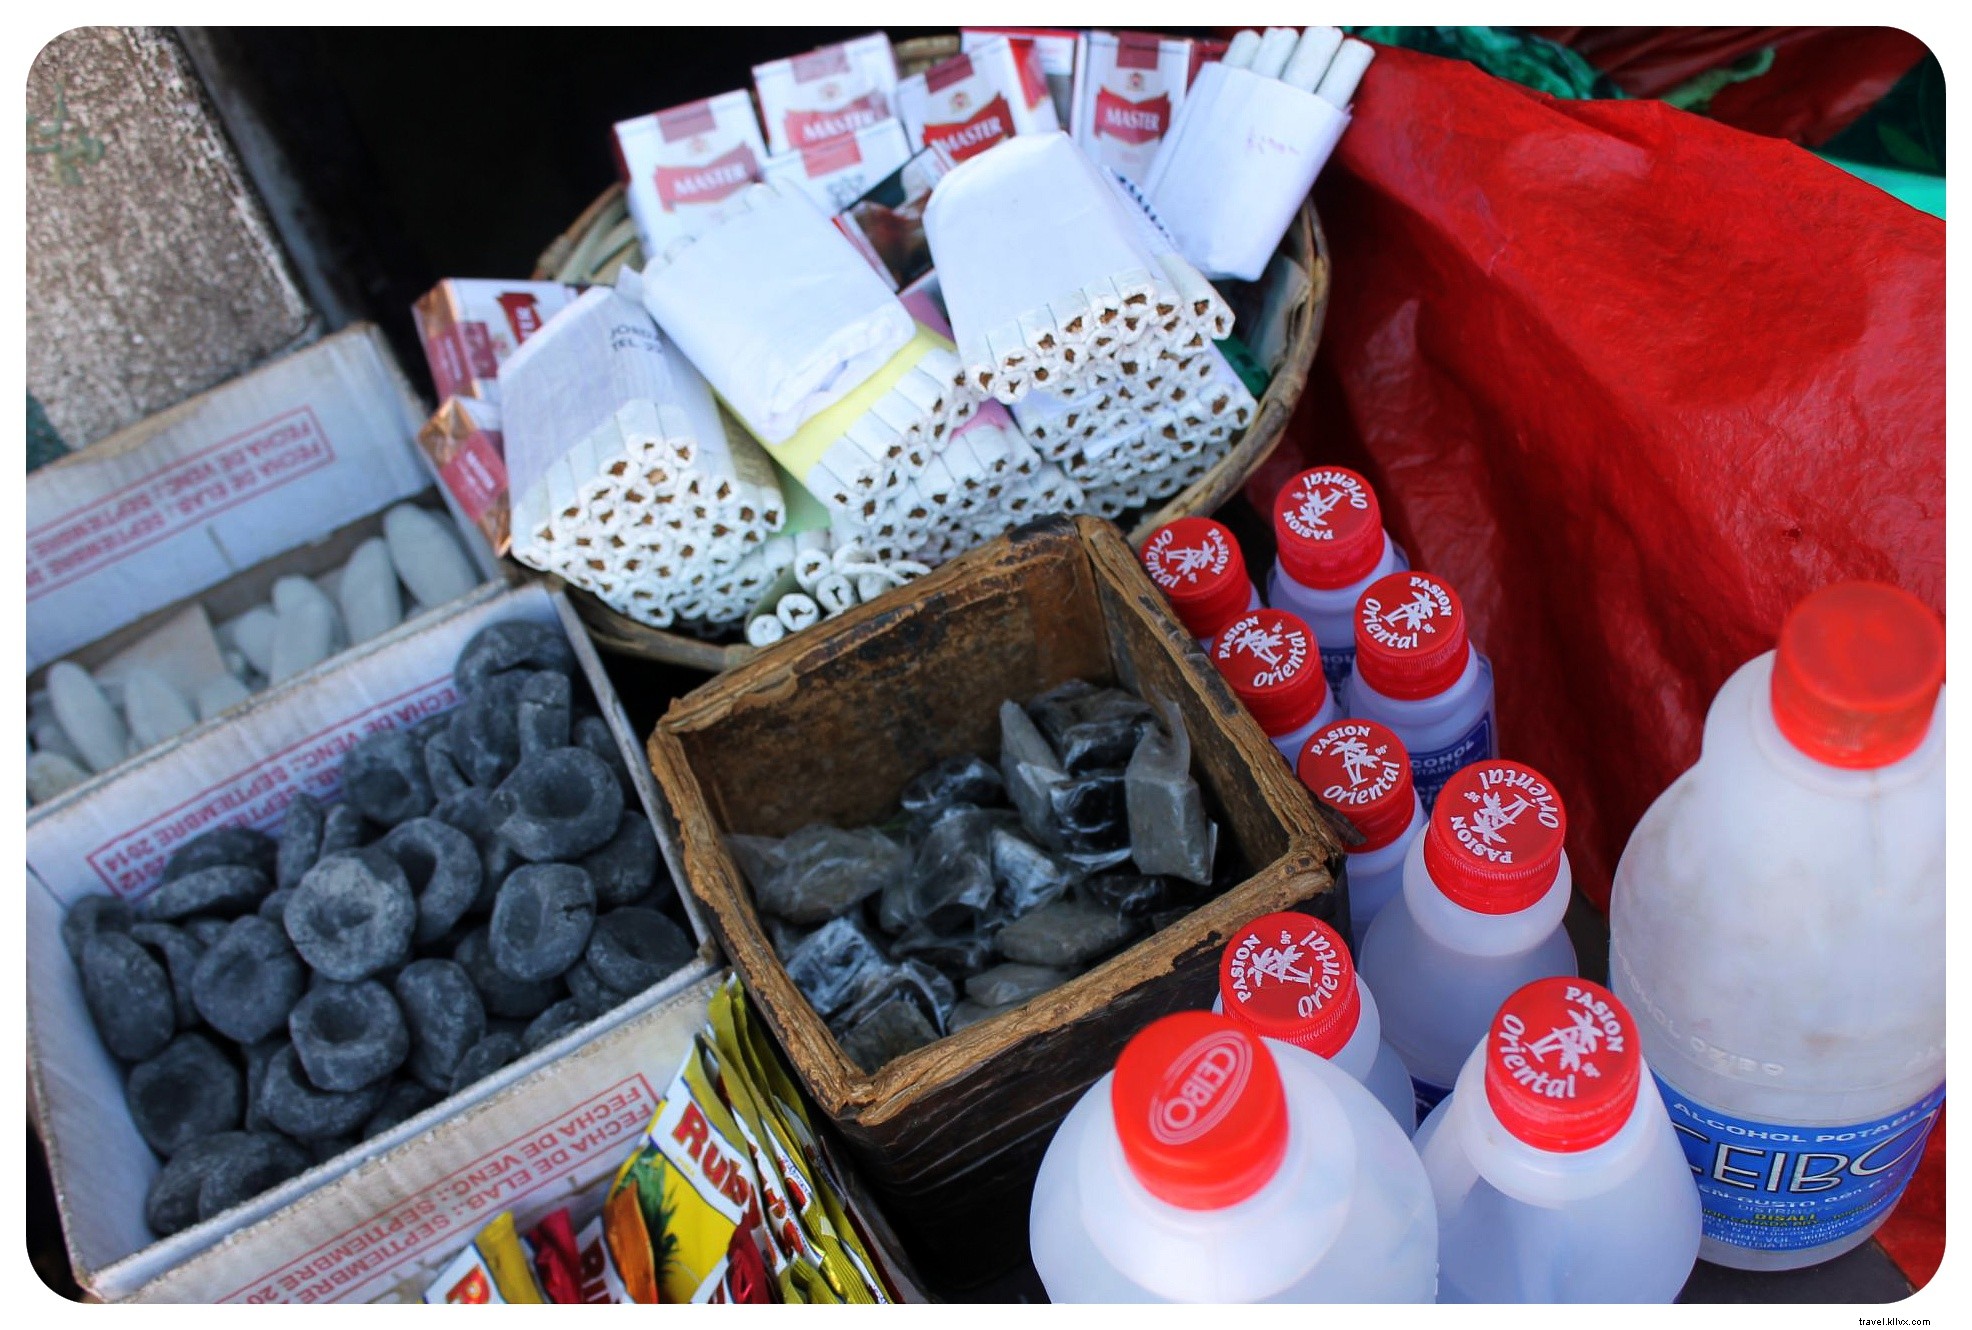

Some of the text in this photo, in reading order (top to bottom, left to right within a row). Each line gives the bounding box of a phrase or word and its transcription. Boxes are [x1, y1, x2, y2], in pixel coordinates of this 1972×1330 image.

[803, 110, 874, 141] MASTER
[943, 115, 1001, 153] MASTER
[1103, 107, 1159, 131] MASTER
[673, 162, 747, 196] MASTER
[1283, 471, 1368, 540] PASION Oriental
[1145, 529, 1181, 588] Oriental
[1409, 576, 1452, 616] PASION
[1362, 597, 1418, 649] Oriental
[1218, 615, 1307, 687] PASION Oriental
[402, 687, 456, 725] ECHA
[1310, 725, 1371, 756] PASION
[156, 768, 290, 845] SEPTIEMBRE
[1322, 761, 1400, 805] Oriental
[1478, 768, 1559, 829] Oriental
[105, 840, 155, 875] 2014
[1450, 816, 1513, 864] PASION
[1230, 933, 1261, 1003] PASION
[1297, 930, 1340, 1018] Oriental
[1565, 986, 1624, 1052] PASION
[1499, 1013, 1576, 1098] Oriental
[559, 1084, 643, 1138] FECHA
[1163, 1046, 1237, 1129] CEIBO
[521, 1131, 558, 1161] DE
[570, 1101, 653, 1156] FECHA
[1673, 1102, 1806, 1142] ALCOHOL
[533, 1148, 570, 1176] DE
[452, 1167, 533, 1219] ELAB.:
[277, 1199, 437, 1295] SEPTIEMBRE
[298, 1217, 451, 1304] SEPTIEMBRE
[246, 1286, 278, 1304] 20
